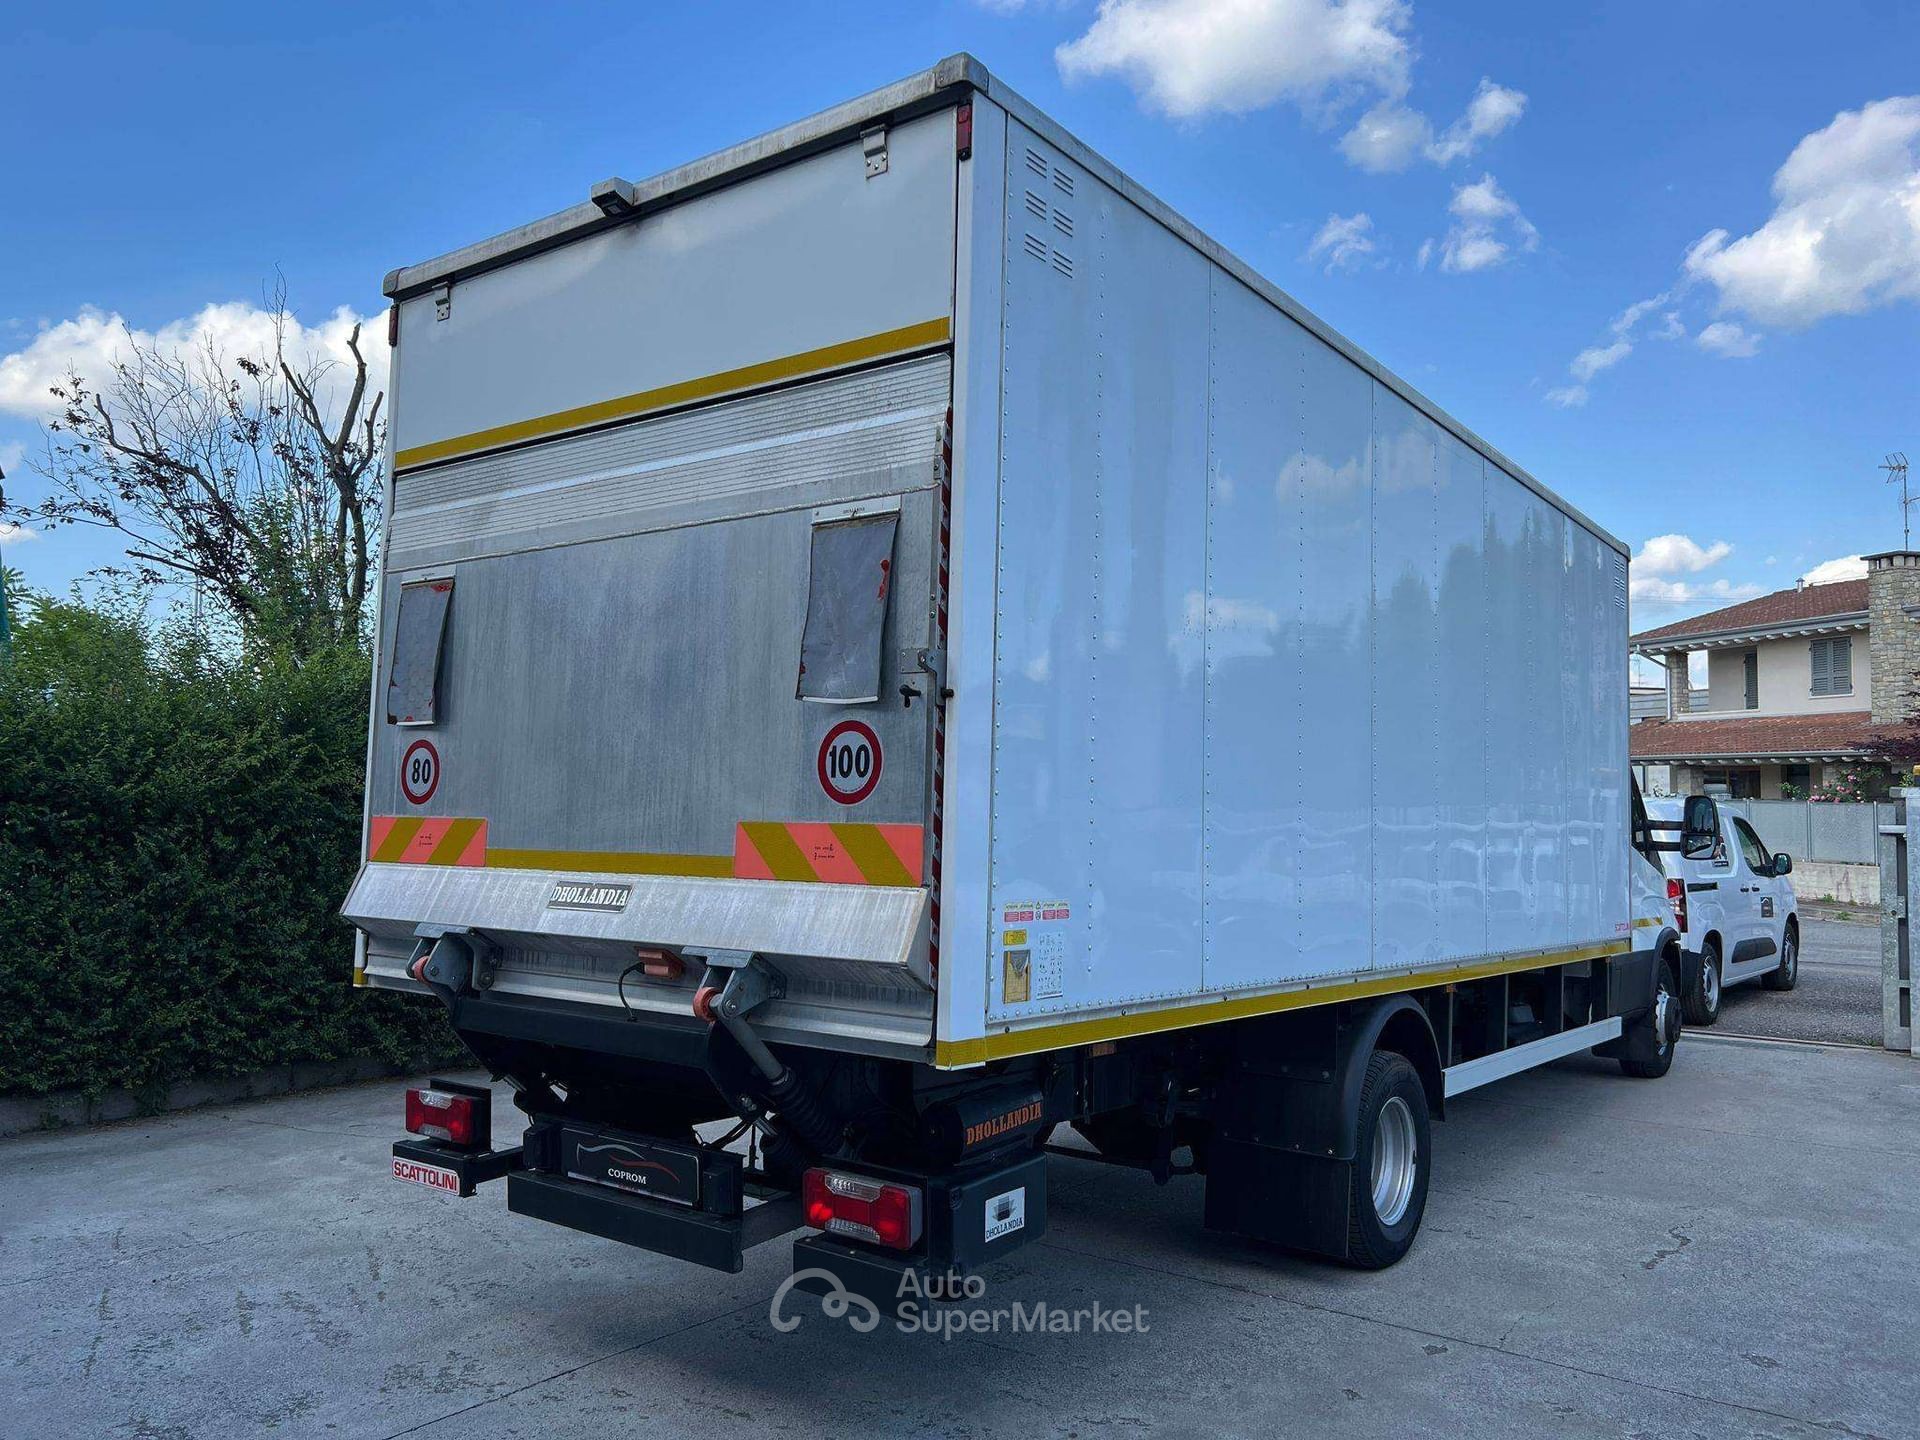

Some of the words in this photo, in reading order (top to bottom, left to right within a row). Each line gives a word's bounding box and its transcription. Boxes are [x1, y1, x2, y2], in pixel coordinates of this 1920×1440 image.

[412, 758, 431, 784] 80
[829, 744, 870, 778] 100
[550, 886, 629, 906] DHOLLANDIA
[966, 1102, 1042, 1145] DHOLLANDIA
[394, 1162, 457, 1190] SCATTOLINI
[608, 1168, 647, 1184] COPROM
[986, 1217, 1023, 1239] DHOLLANDIA
